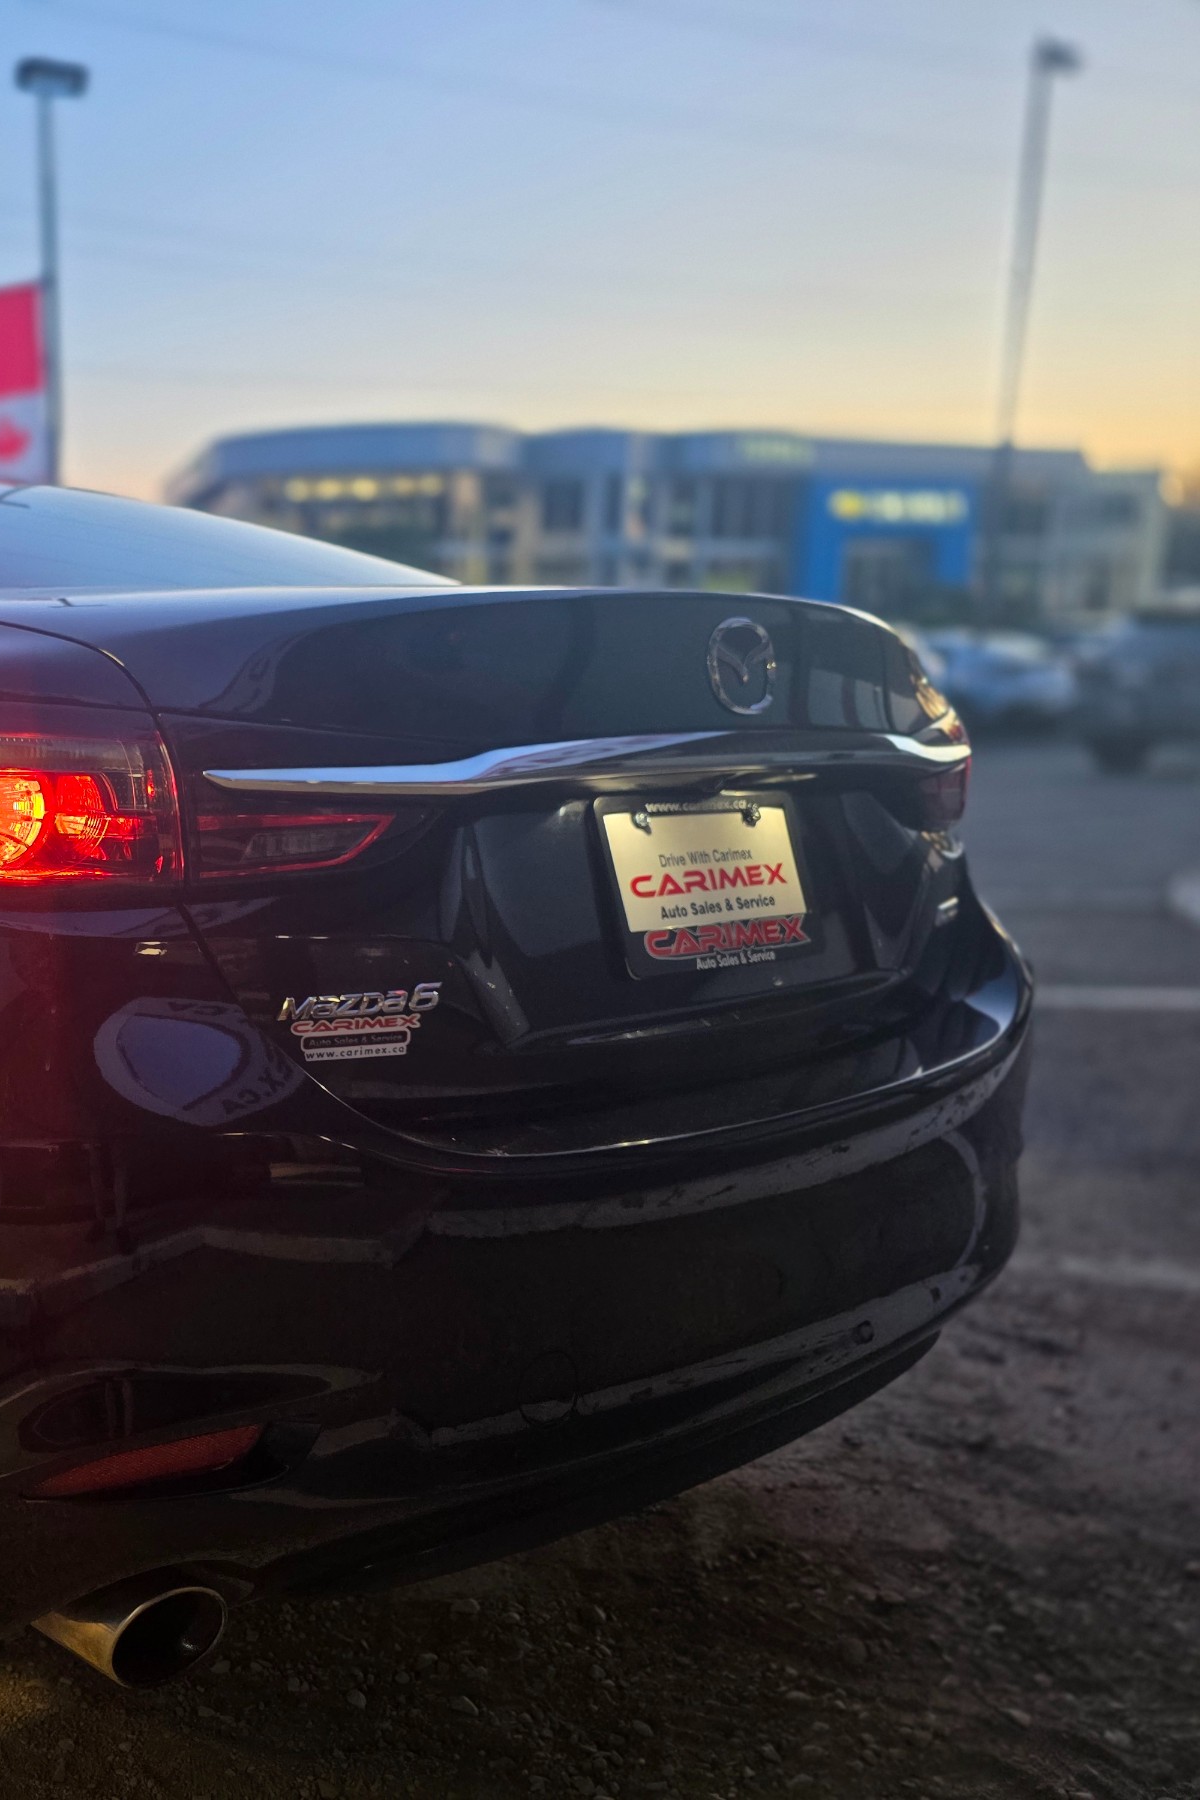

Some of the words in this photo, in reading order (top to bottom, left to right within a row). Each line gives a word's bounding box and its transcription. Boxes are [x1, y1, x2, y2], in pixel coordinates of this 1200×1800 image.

[659, 854, 686, 868] Drive
[689, 850, 711, 865] With
[712, 847, 753, 863] Carimex
[630, 862, 788, 899] CARIMEX
[660, 904, 688, 920] Auto
[690, 900, 722, 916] Sales
[725, 899, 735, 911] &
[736, 894, 775, 909] Service
[646, 916, 808, 957] CARIMEX
[696, 954, 717, 970] Auto
[717, 951, 739, 968] Sales
[747, 949, 776, 964] Service
[291, 1014, 421, 1035] CARIMEX
[308, 1038, 332, 1048] Auto
[333, 1036, 359, 1046] Sales
[371, 1032, 404, 1043] Service
[305, 1045, 406, 1060] www.carimex.ca
